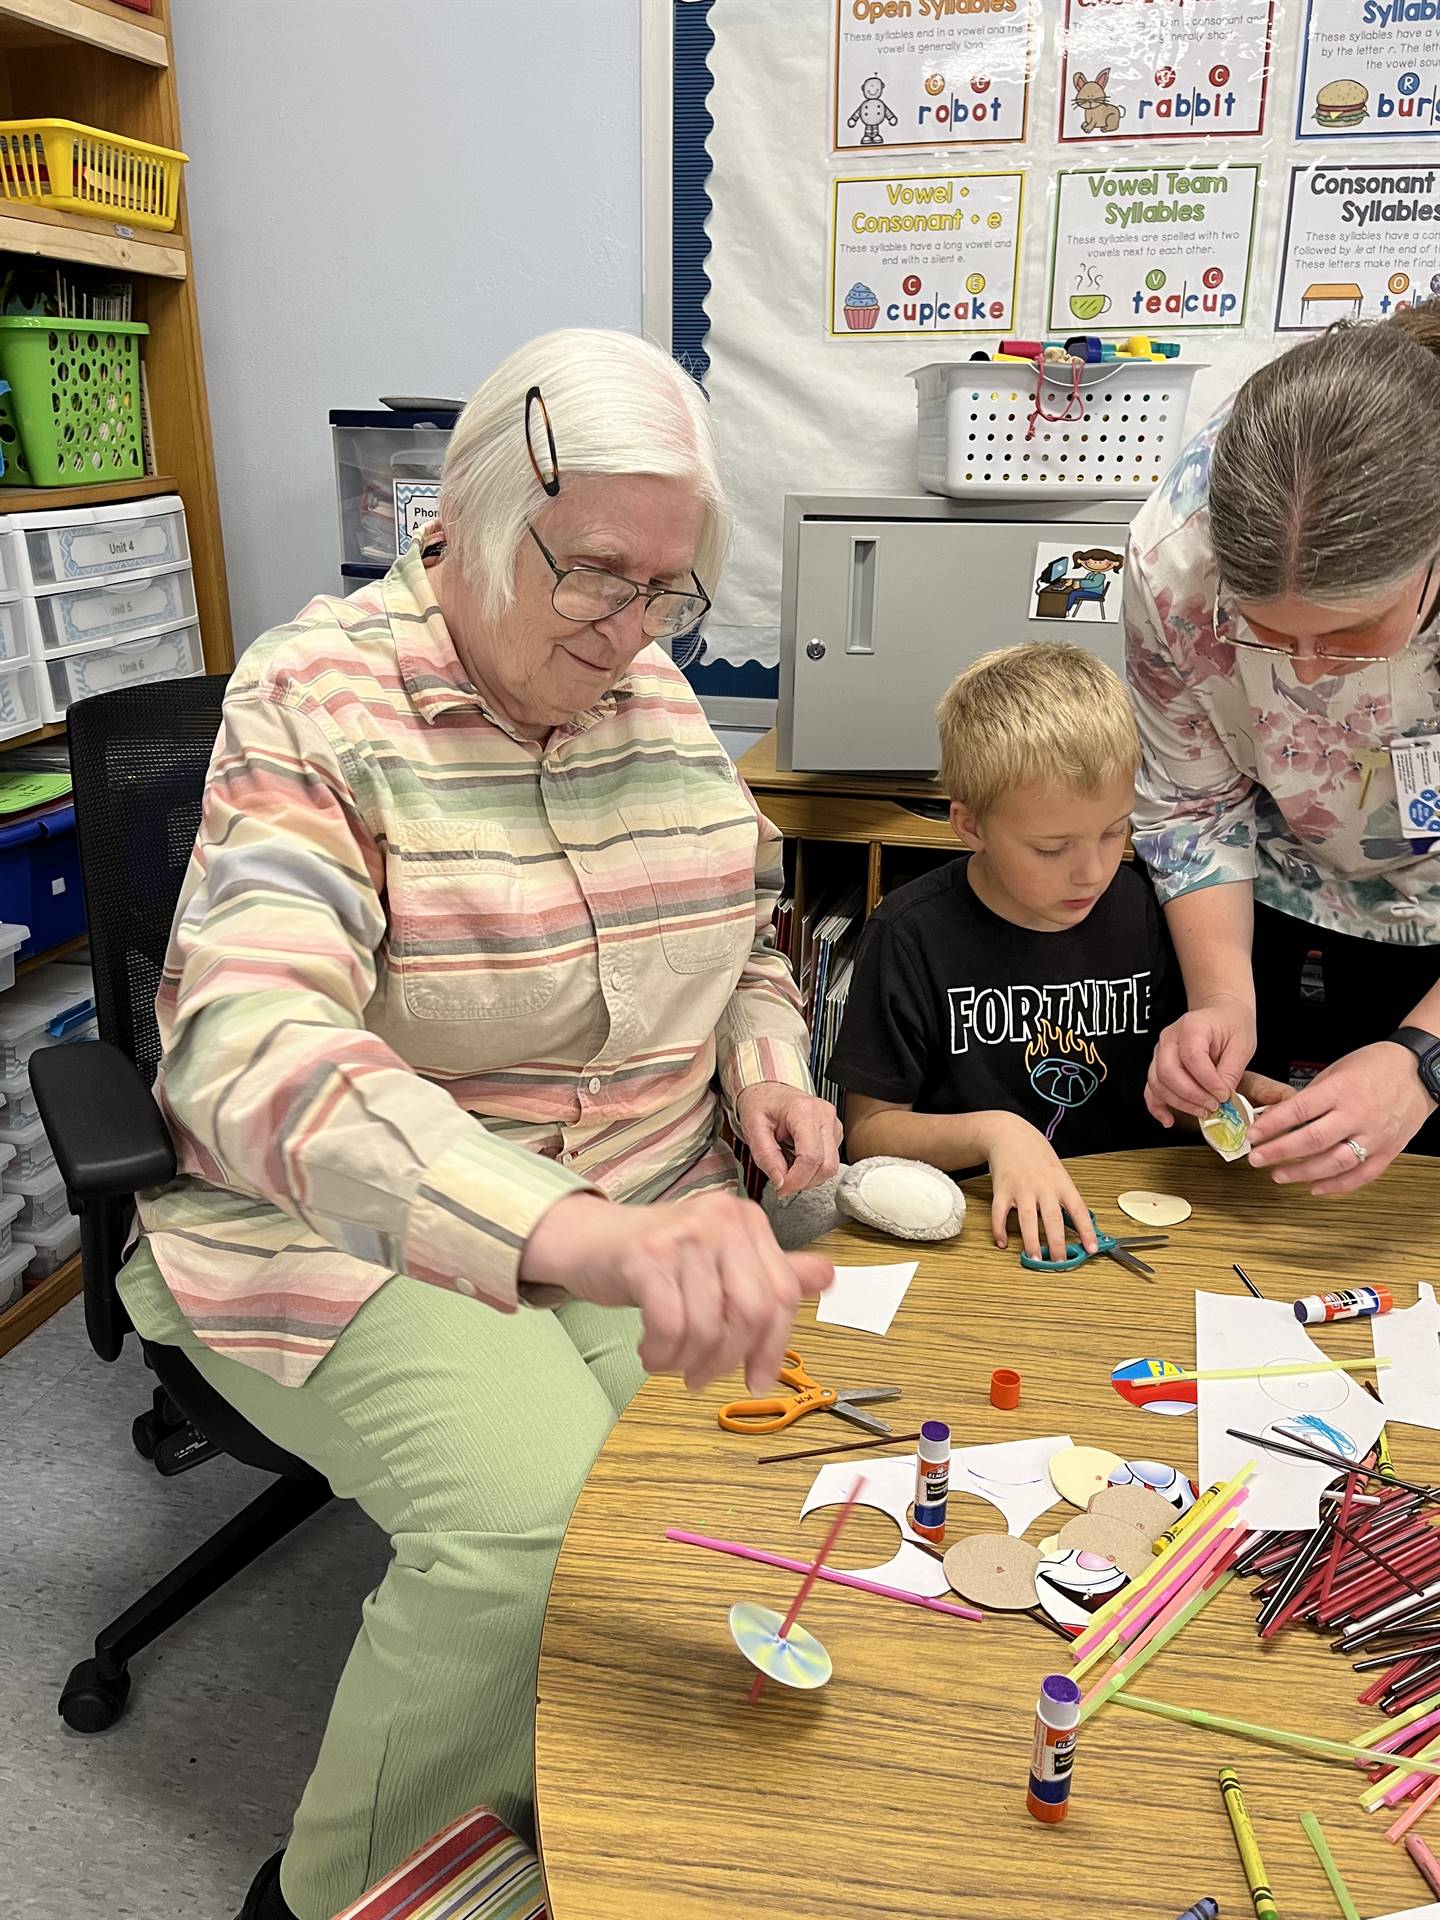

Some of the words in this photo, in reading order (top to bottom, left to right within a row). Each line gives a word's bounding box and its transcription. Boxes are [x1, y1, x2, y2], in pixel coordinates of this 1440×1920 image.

[852, 0, 911, 24] Open
[918, 0, 1016, 20] Syllables
[844, 32, 872, 42] These
[875, 30, 913, 41] syllables
[917, 28, 934, 38] end
[937, 27, 945, 36] in
[948, 28, 954, 36] a
[956, 26, 985, 36] vowel
[987, 25, 1004, 34] and
[1315, 33, 1345, 42] These
[1349, 31, 1392, 42] syllables
[1396, 29, 1420, 38] have
[878, 43, 904, 54] vowel
[907, 42, 915, 52] is
[918, 41, 960, 53] generally
[1322, 48, 1333, 58] by
[1337, 46, 1352, 56] the
[1356, 45, 1384, 56] letter
[1400, 44, 1420, 53] The
[1423, 42, 1440, 52] lett
[1366, 60, 1382, 69] the
[1386, 58, 1416, 68] vowel
[1088, 173, 1158, 197] Vowel
[1166, 172, 1228, 195] Team
[1311, 172, 1436, 195] Consonant
[886, 181, 954, 205] Vowel
[852, 209, 963, 234] Consonant
[987, 212, 1002, 229] e
[1105, 200, 1205, 228] Syllables
[1067, 235, 1096, 245] These
[1098, 233, 1138, 246] syllables
[1142, 234, 1158, 242] are
[1162, 232, 1194, 244] spelled
[1198, 230, 1218, 240] with
[1221, 230, 1240, 240] two
[1306, 232, 1336, 240] These
[1339, 231, 1382, 242] syllables
[1385, 231, 1410, 240] have
[840, 243, 866, 253] These
[870, 242, 907, 254] syllables
[910, 240, 932, 250] have
[935, 242, 941, 250] a
[943, 240, 962, 251] long
[965, 239, 992, 249] vowel
[994, 238, 1012, 248] and
[1088, 247, 1120, 258] vowels
[1124, 247, 1144, 256] next
[1146, 247, 1156, 256] to
[1159, 246, 1182, 256] each
[1186, 245, 1215, 254] other.
[1294, 246, 1336, 255] followed
[1340, 246, 1350, 256] by
[1366, 246, 1376, 254] at
[1379, 244, 1394, 254] the
[1398, 244, 1416, 254] end
[1420, 244, 1432, 254] of
[882, 255, 898, 265] end
[901, 254, 920, 264] with
[922, 256, 928, 264] a
[931, 253, 954, 264] silent
[1296, 260, 1325, 269] These
[1328, 258, 1360, 268] letters
[1364, 258, 1390, 268] make
[1394, 258, 1410, 268] the
[1413, 257, 1436, 268] final
[109, 542, 127, 554] Unit
[128, 540, 134, 552] 4
[126, 602, 132, 612] 5
[120, 661, 138, 674] Unit
[138, 659, 144, 670] 6
[947, 971, 1151, 1054] FORTNITE
